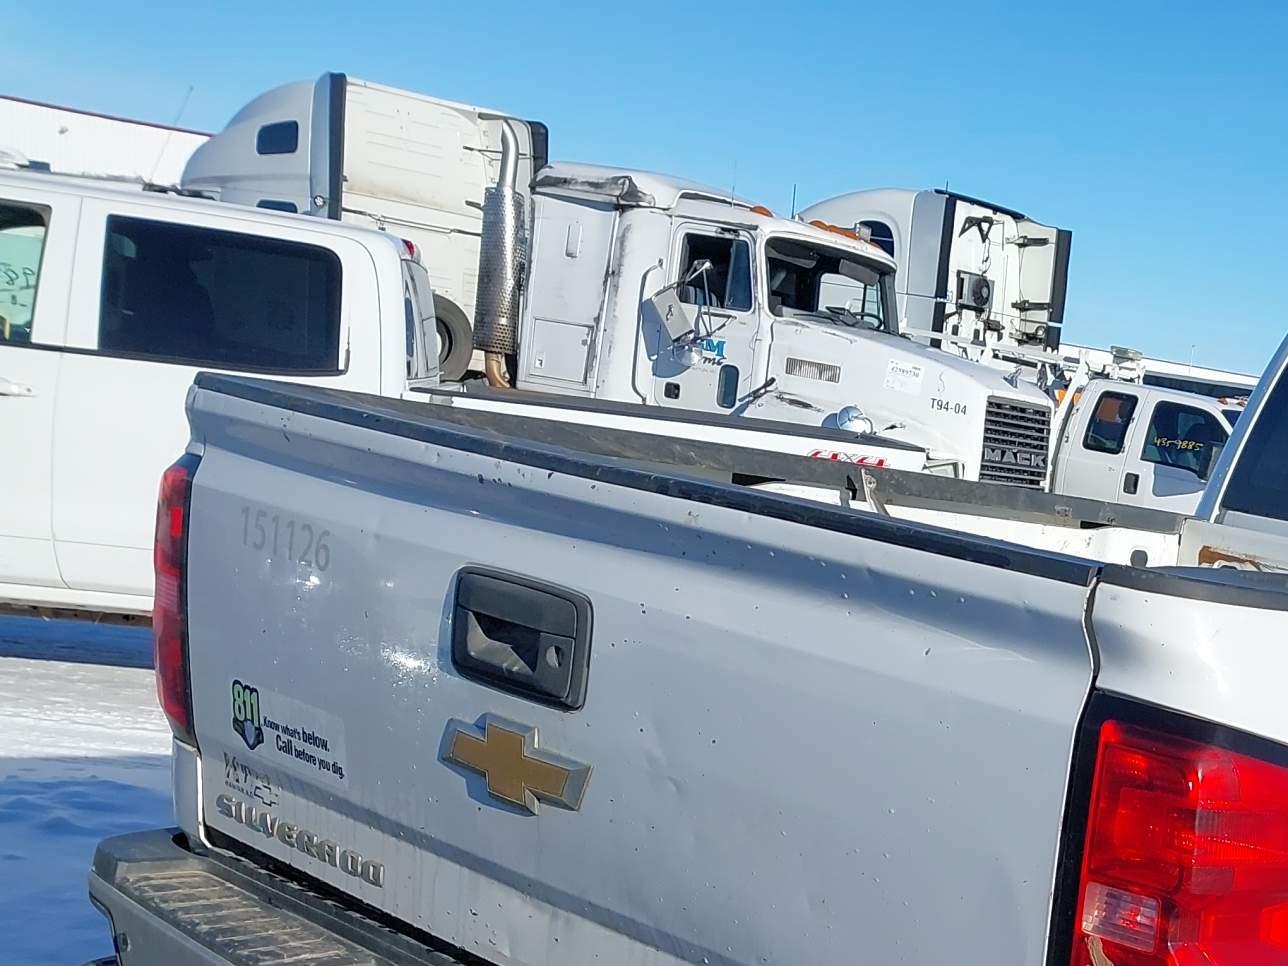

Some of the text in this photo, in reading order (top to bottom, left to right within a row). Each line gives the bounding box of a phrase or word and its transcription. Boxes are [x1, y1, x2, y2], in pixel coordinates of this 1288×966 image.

[930, 398, 967, 415] T94-04
[984, 447, 1046, 467] MACK
[241, 505, 331, 572] 151126
[232, 679, 260, 728] 811
[263, 715, 330, 752] Know what's below.
[276, 734, 294, 757] Call
[294, 744, 317, 766] before
[317, 757, 331, 771] you
[215, 793, 386, 889] SILVERADO
